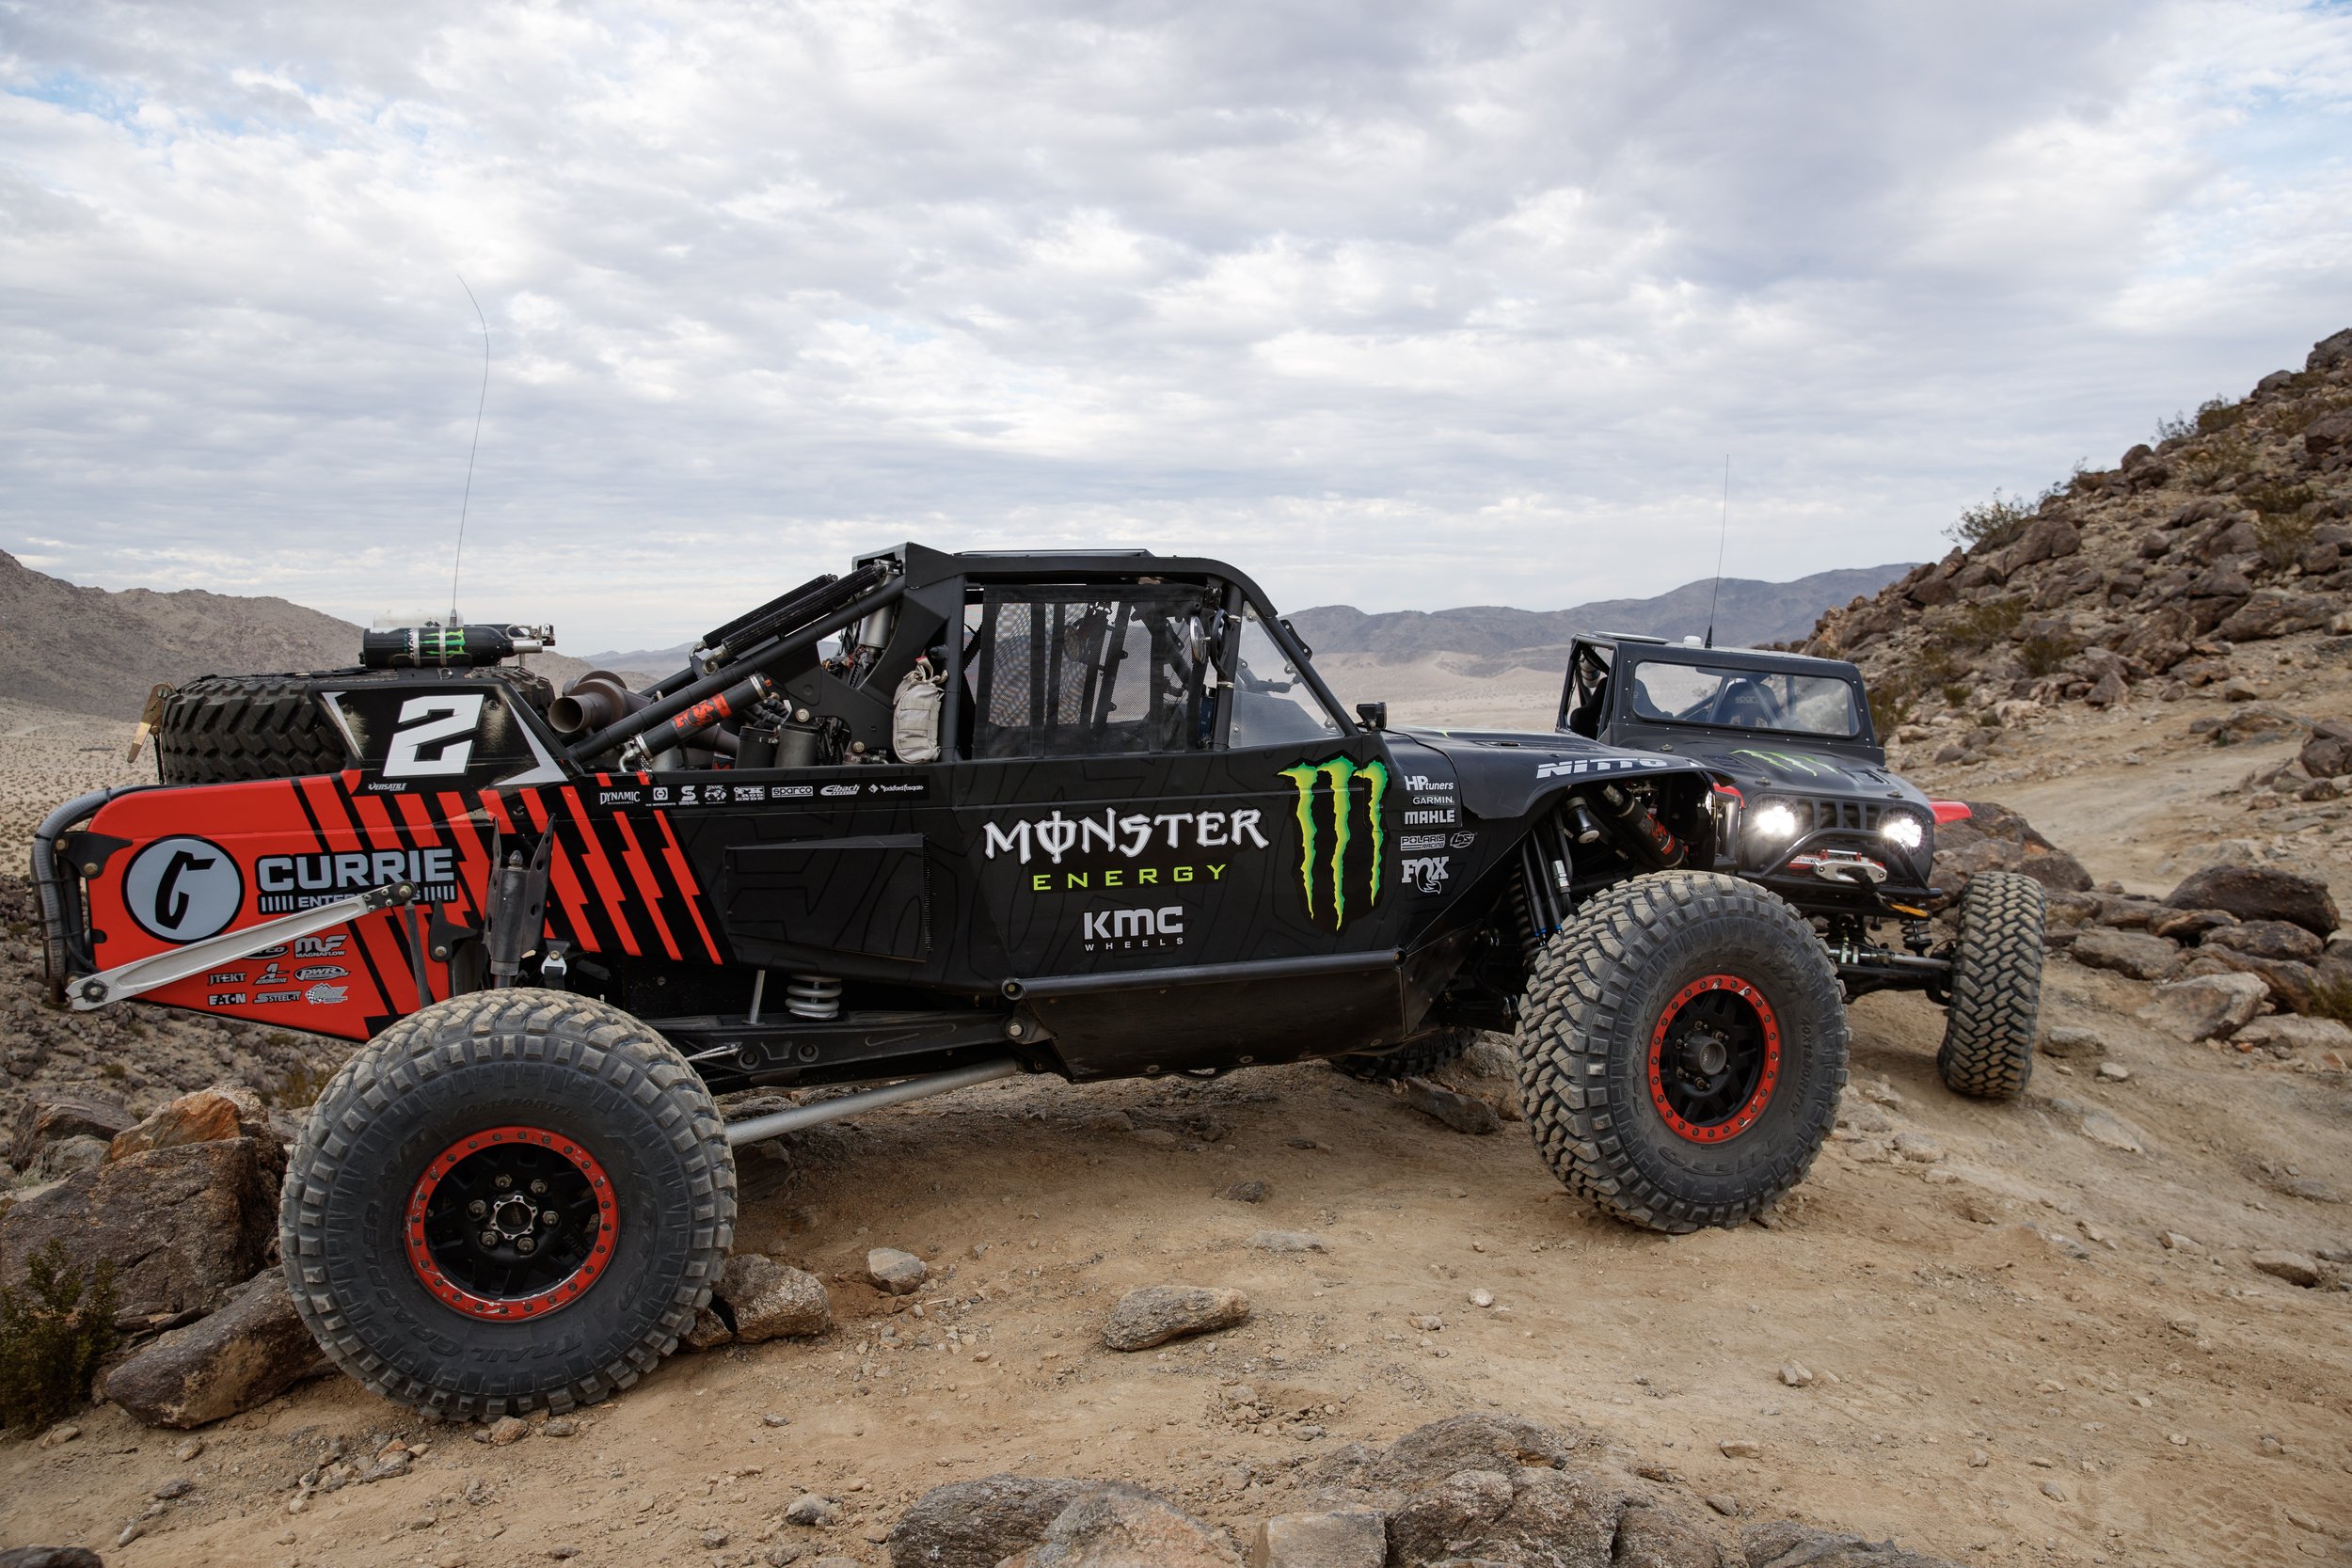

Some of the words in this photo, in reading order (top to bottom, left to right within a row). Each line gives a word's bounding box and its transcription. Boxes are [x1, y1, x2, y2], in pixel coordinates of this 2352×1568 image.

[383, 694, 485, 777] 2
[1535, 758, 1668, 779] NITTO
[772, 787, 813, 796] sparco
[820, 784, 860, 796] Eibach
[600, 791, 641, 805] DYNAMIC
[1413, 796, 1454, 805] GARMIN
[1405, 810, 1455, 825] MAHLE
[983, 807, 1269, 864] MONSTER
[1401, 834, 1446, 845] POLARIS
[259, 848, 454, 893] CURRIE
[1033, 864, 1227, 892] ENERGY
[1401, 856, 1450, 889] FOX
[1085, 937, 1184, 952] WHEELS
[209, 973, 246, 985] JTEKT
